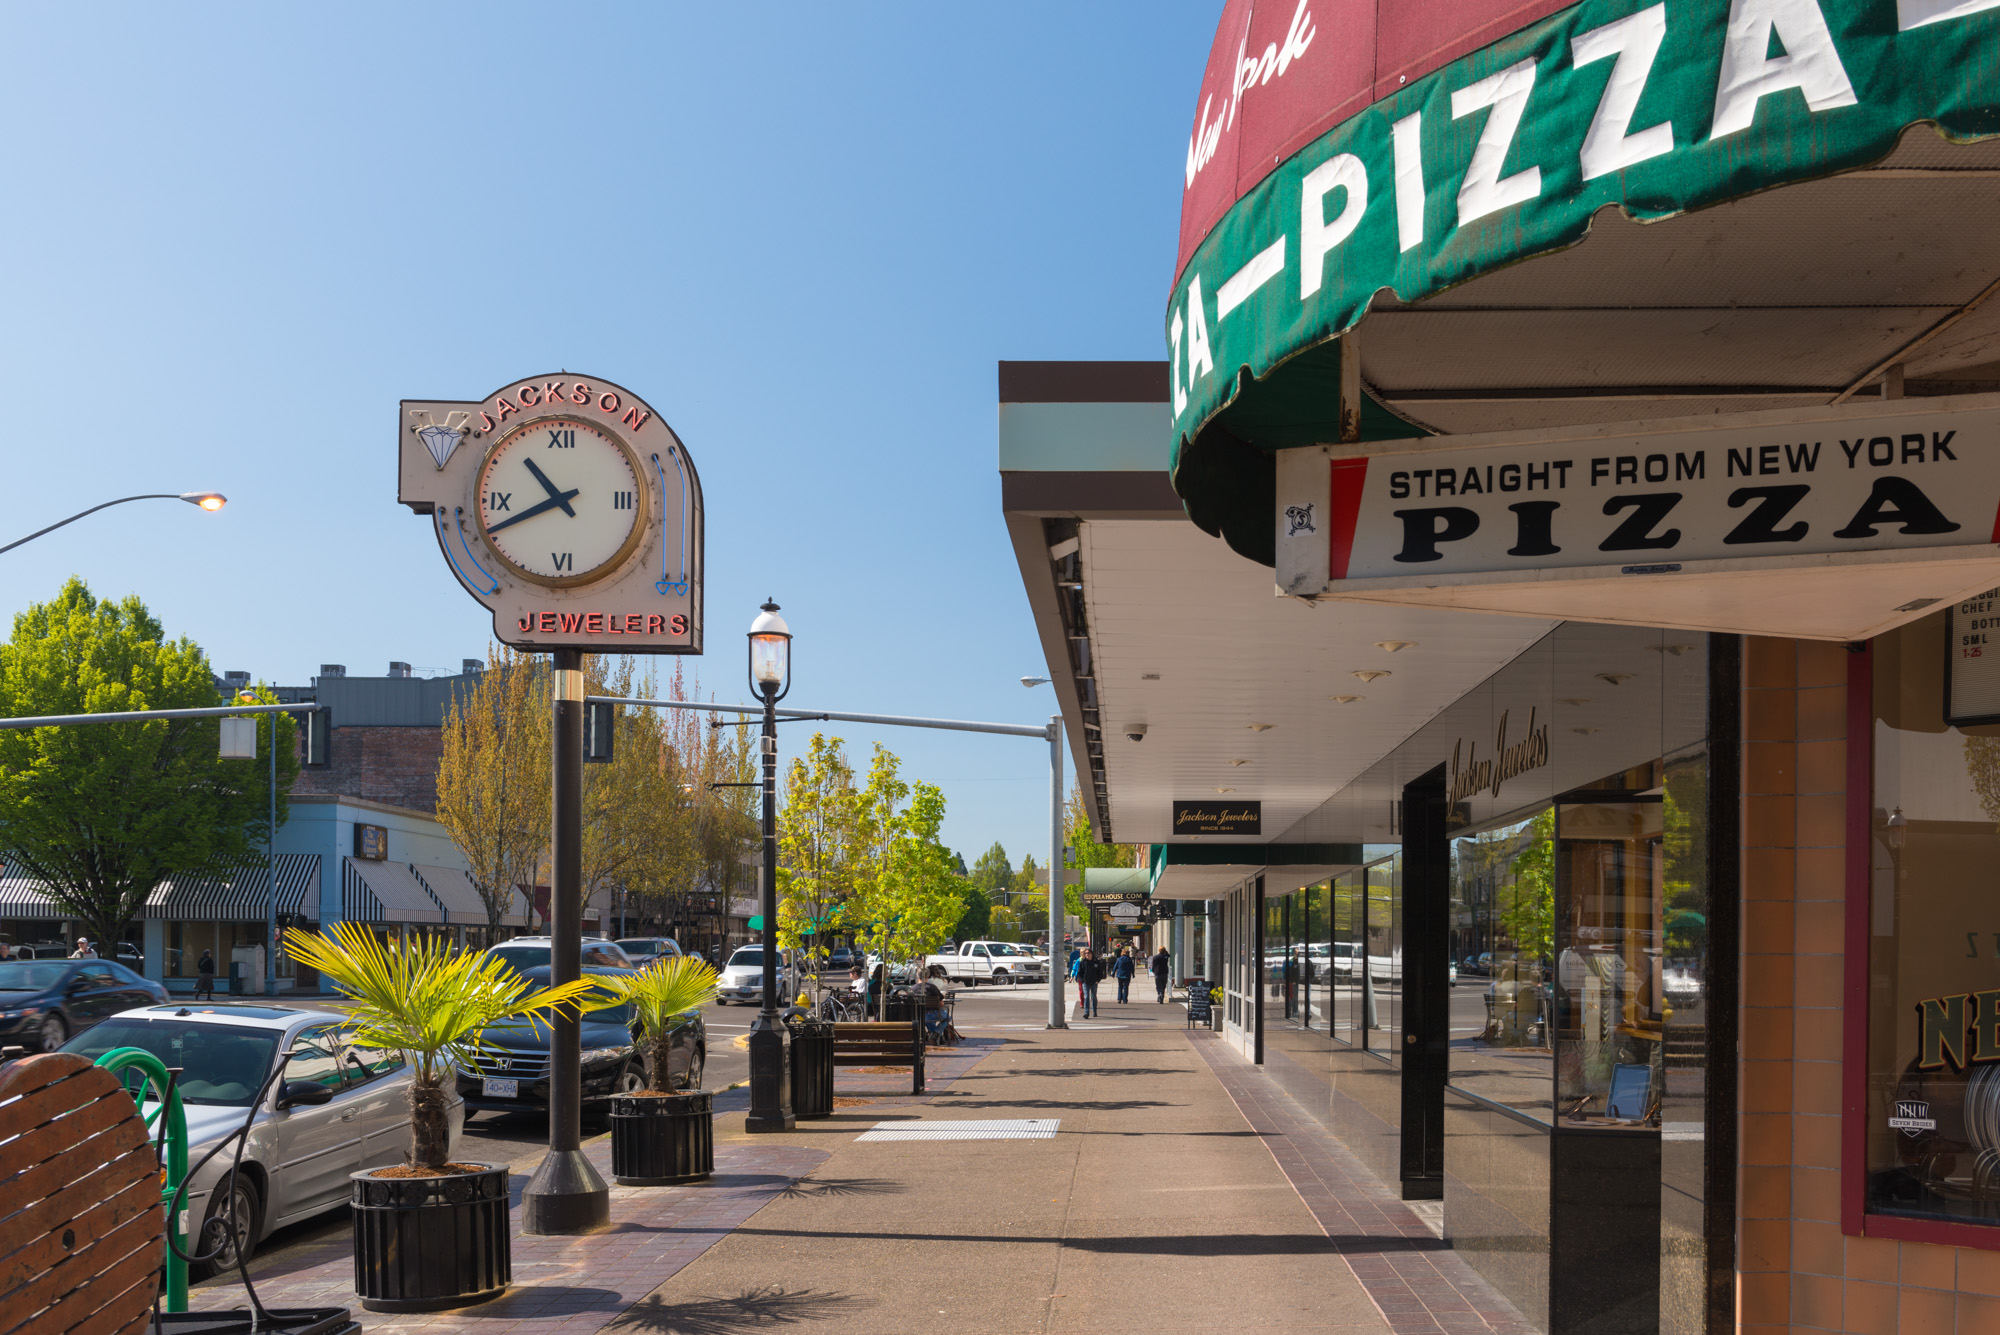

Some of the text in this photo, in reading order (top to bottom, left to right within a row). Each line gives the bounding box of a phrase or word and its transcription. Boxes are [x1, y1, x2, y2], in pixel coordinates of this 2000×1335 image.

[1301, 0, 1859, 301] PIZZA
[479, 382, 651, 434] JACKSON
[548, 430, 575, 448] XII
[1389, 431, 1959, 499] STRAIGHT FROM NEW YORK
[490, 491, 632, 511] IX III
[1392, 476, 1962, 563] PIZZA
[551, 553, 573, 571] VI
[1962, 601, 1993, 614] CHEF
[518, 611, 690, 636] JEWELERS
[1176, 810, 1258, 825] Jackson Jewelers
